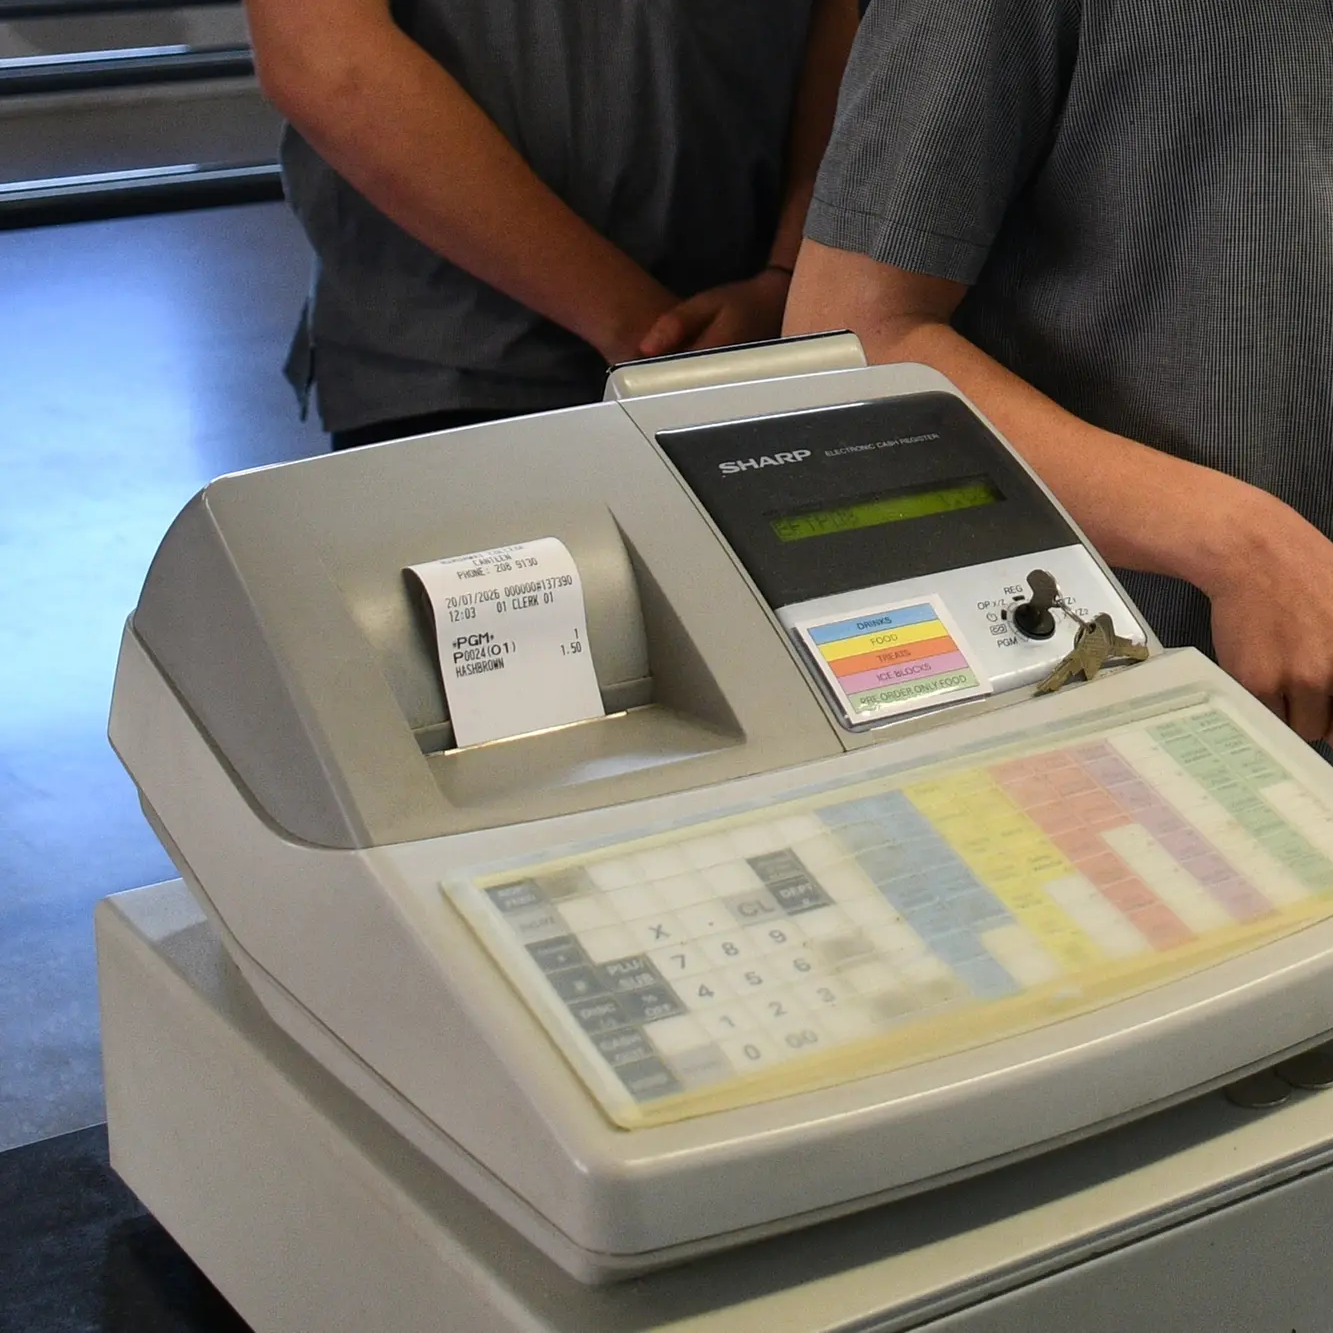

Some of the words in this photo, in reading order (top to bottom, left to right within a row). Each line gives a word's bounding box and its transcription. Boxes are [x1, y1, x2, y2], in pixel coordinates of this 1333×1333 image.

[719, 449, 812, 474] SHARP
[824, 443, 875, 457] ELECTRONIC
[876, 439, 899, 449] CASH
[899, 433, 940, 445] REGISTER
[472, 554, 512, 566] CANTEEN
[445, 589, 500, 608] 20/07/2026
[1003, 585, 1023, 595] REG
[449, 608, 476, 622] 12:03
[496, 602, 507, 613] 01
[512, 597, 539, 611] CLERK
[544, 592, 554, 603] 01
[977, 600, 990, 610] OP
[856, 616, 892, 630] DRINKS
[870, 634, 898, 646] FOOD
[997, 637, 1018, 648] PGM
[456, 658, 505, 678] HASHBROWN
[560, 642, 582, 656] 1.50
[877, 649, 911, 663] TREATS
[877, 670, 895, 682] ICE
[895, 663, 931, 678] BLOCKS
[880, 686, 913, 701] ORDER
[914, 680, 939, 694] ONLY
[940, 675, 967, 688] FOOD
[738, 900, 775, 917] CL
[670, 954, 686, 969] 7
[721, 942, 739, 956] 8
[769, 929, 787, 943] 9
[698, 984, 715, 998] 4
[744, 971, 763, 986] 5
[793, 958, 811, 973] 6
[719, 1016, 735, 1028] 1
[769, 1001, 787, 1017] 2
[816, 987, 836, 1002] 3
[743, 1044, 761, 1060] 0
[785, 1030, 819, 1049] 00
